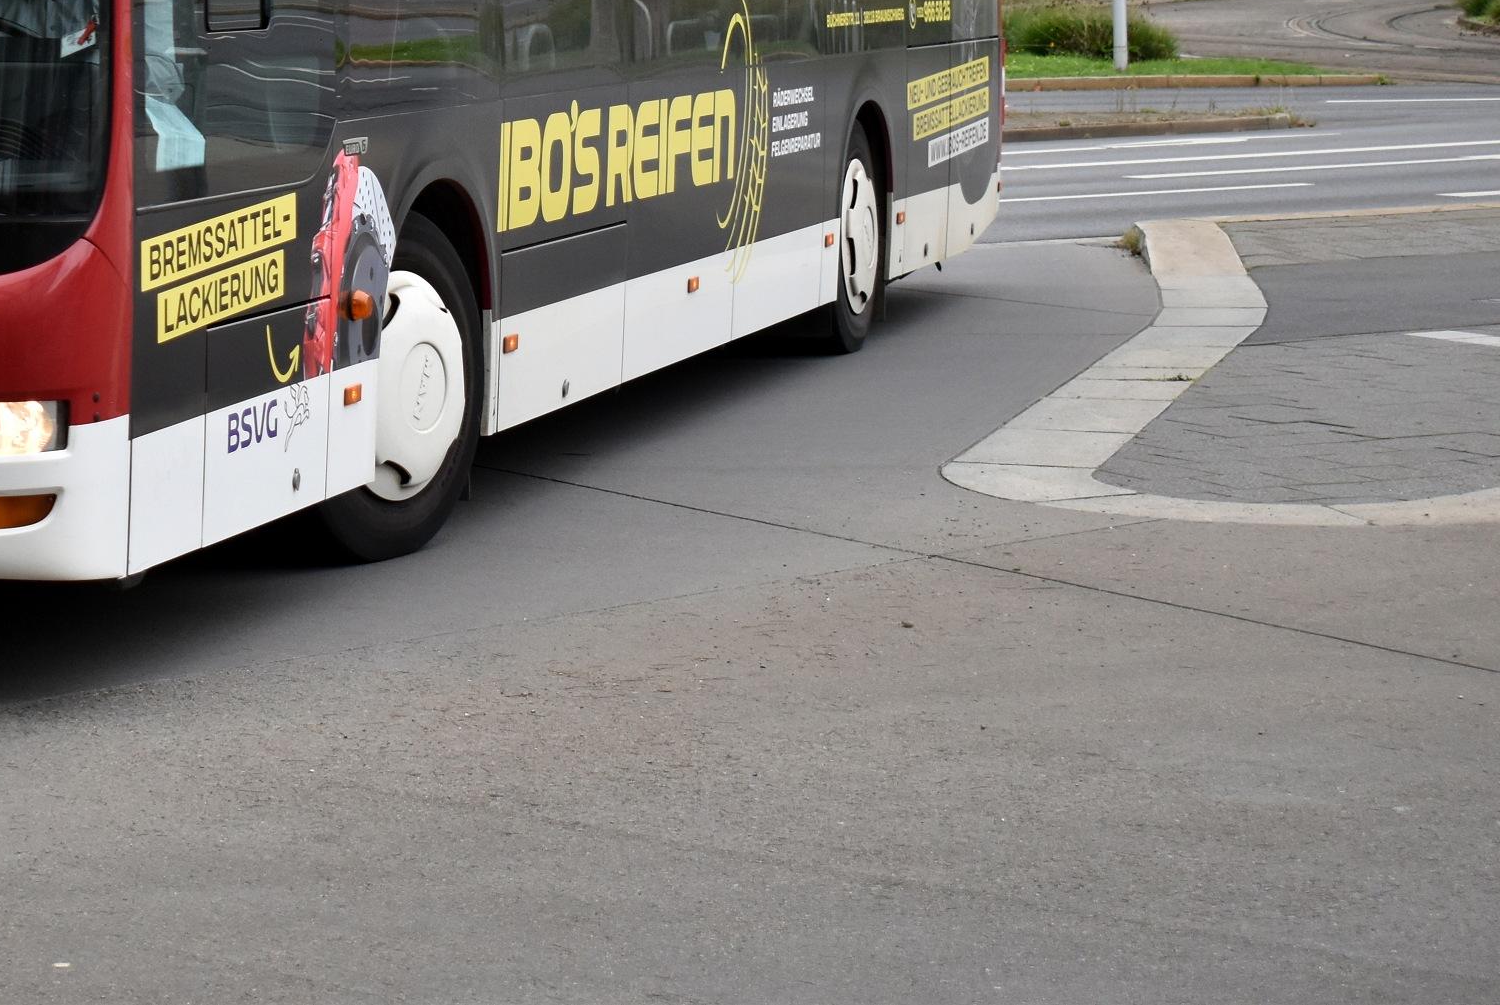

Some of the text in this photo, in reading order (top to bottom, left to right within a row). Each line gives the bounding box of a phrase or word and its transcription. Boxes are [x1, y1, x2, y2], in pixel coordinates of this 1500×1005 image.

[606, 89, 735, 207] REIFEN
[771, 132, 820, 157] FELGENREPARATUR
[772, 111, 808, 132] EINLAGERUNG
[150, 205, 291, 281] BREMSSATTEL-
[164, 258, 279, 334] LACKIERUNG
[227, 399, 277, 453] BSVG
